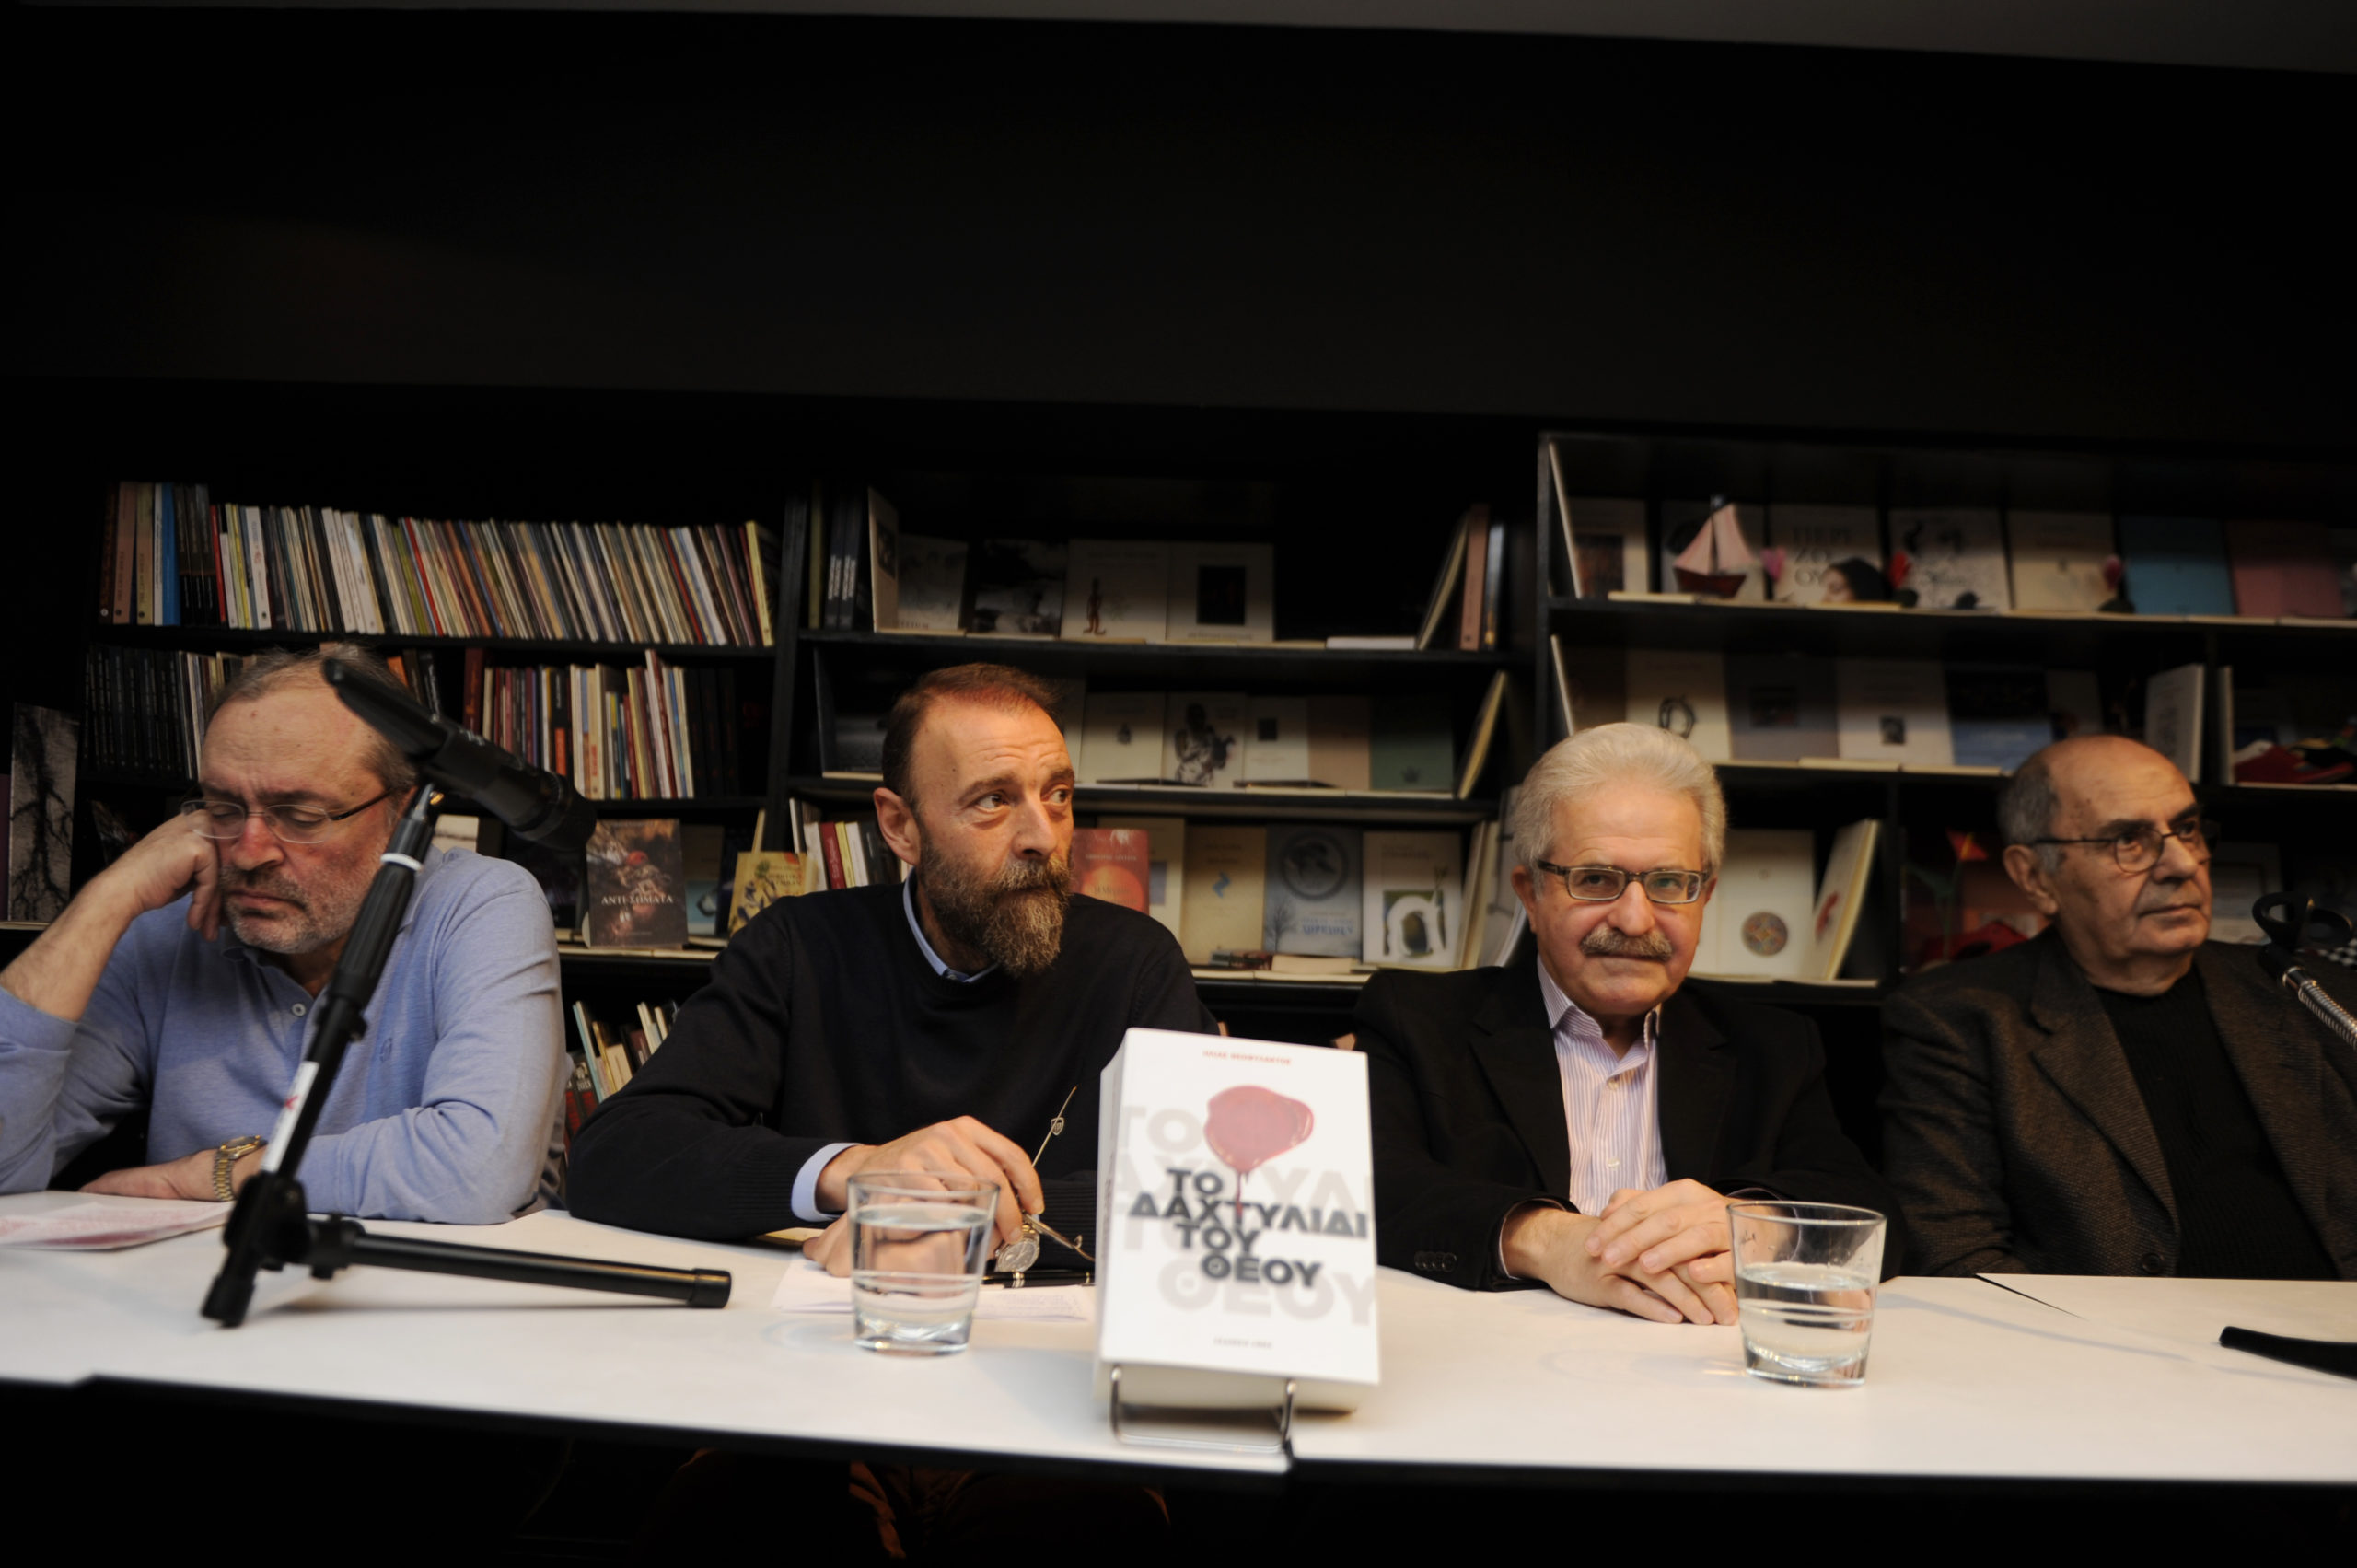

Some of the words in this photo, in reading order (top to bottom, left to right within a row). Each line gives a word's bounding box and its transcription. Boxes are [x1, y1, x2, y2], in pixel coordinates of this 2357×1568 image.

[1166, 1167, 1225, 1196] ΤΟ
[1128, 1192, 1368, 1239] ΔΑΧΤΥΛΙΔΙ
[1174, 1223, 1260, 1253] ΤΟΥ
[1201, 1254, 1323, 1288] ΘΕΟΥ
